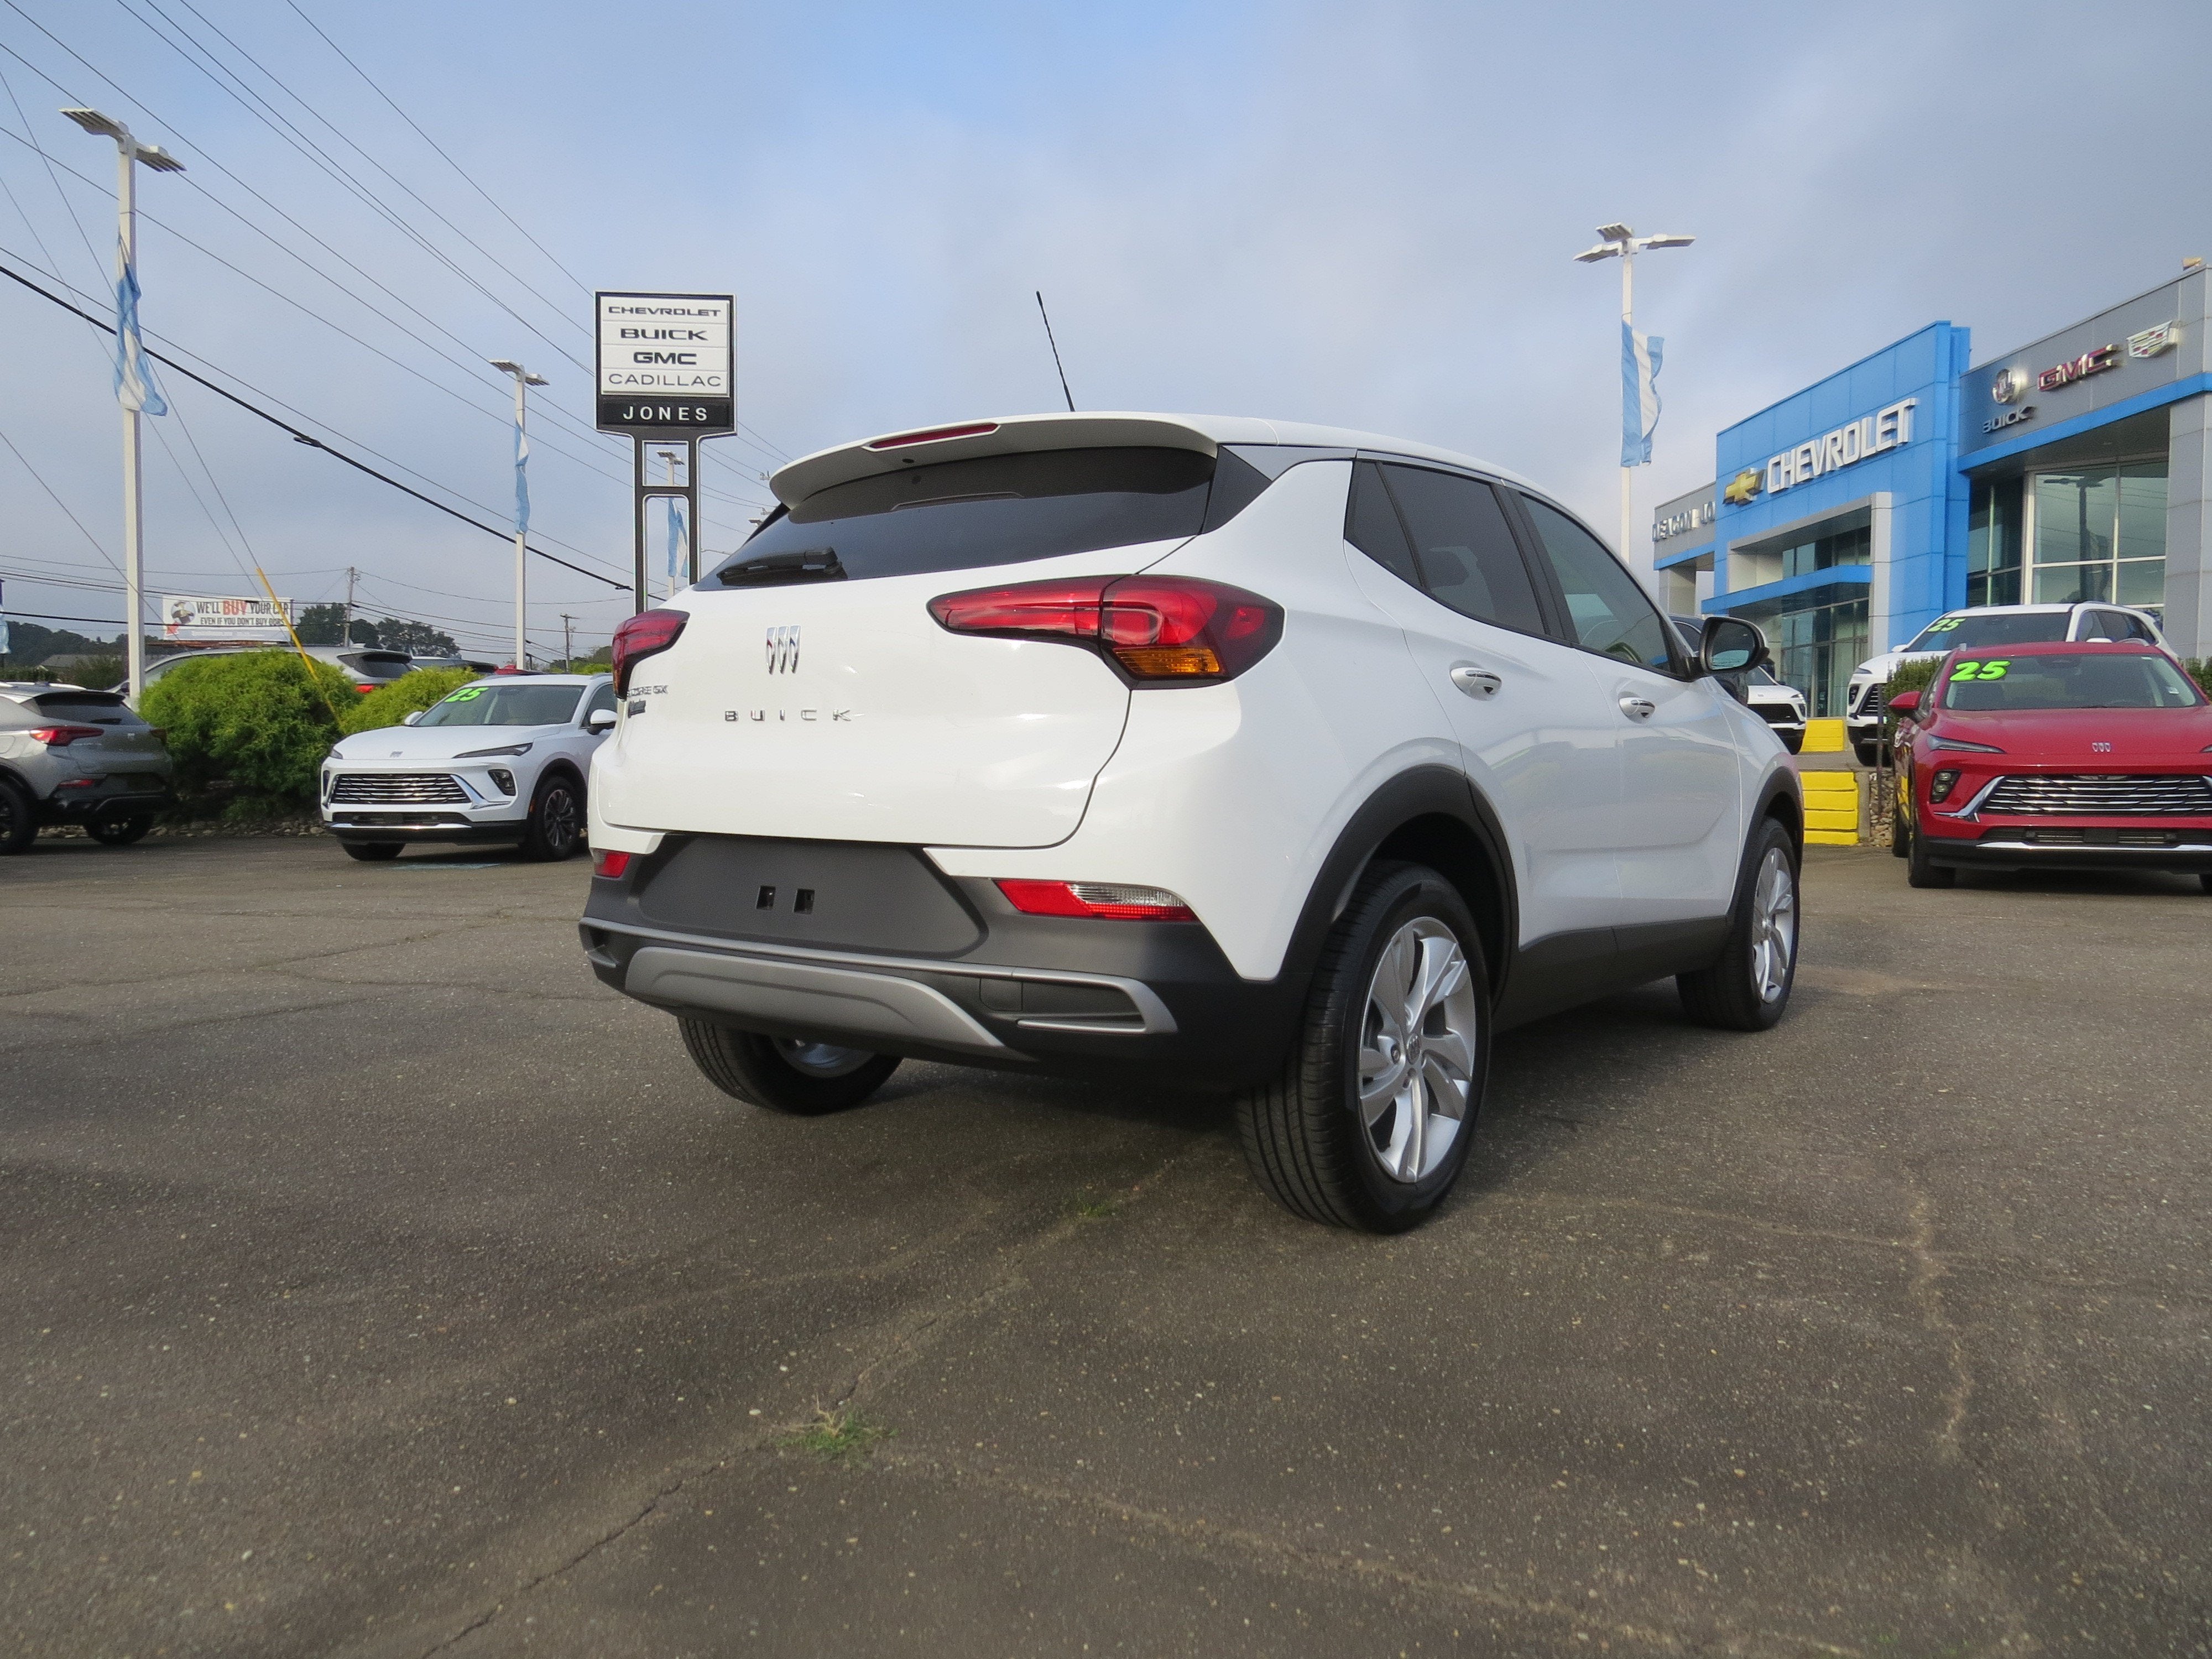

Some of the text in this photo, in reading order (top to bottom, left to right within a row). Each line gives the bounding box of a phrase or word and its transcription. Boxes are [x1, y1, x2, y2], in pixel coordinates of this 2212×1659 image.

[608, 306, 721, 317] CHEVROLET
[620, 328, 708, 341] BUICK
[633, 352, 697, 365] GMC
[2038, 344, 2114, 392] GMC
[609, 373, 721, 387] CADILLAC
[623, 406, 707, 421] JONES
[1983, 406, 2036, 434] BUICK
[1767, 398, 1916, 494] CHEVROLET
[223, 600, 247, 615] BUY
[251, 602, 271, 614] YOUR
[1927, 618, 1966, 633] 25
[1949, 660, 2011, 681] 25
[444, 687, 489, 703] 25
[724, 709, 852, 721] BUICK
